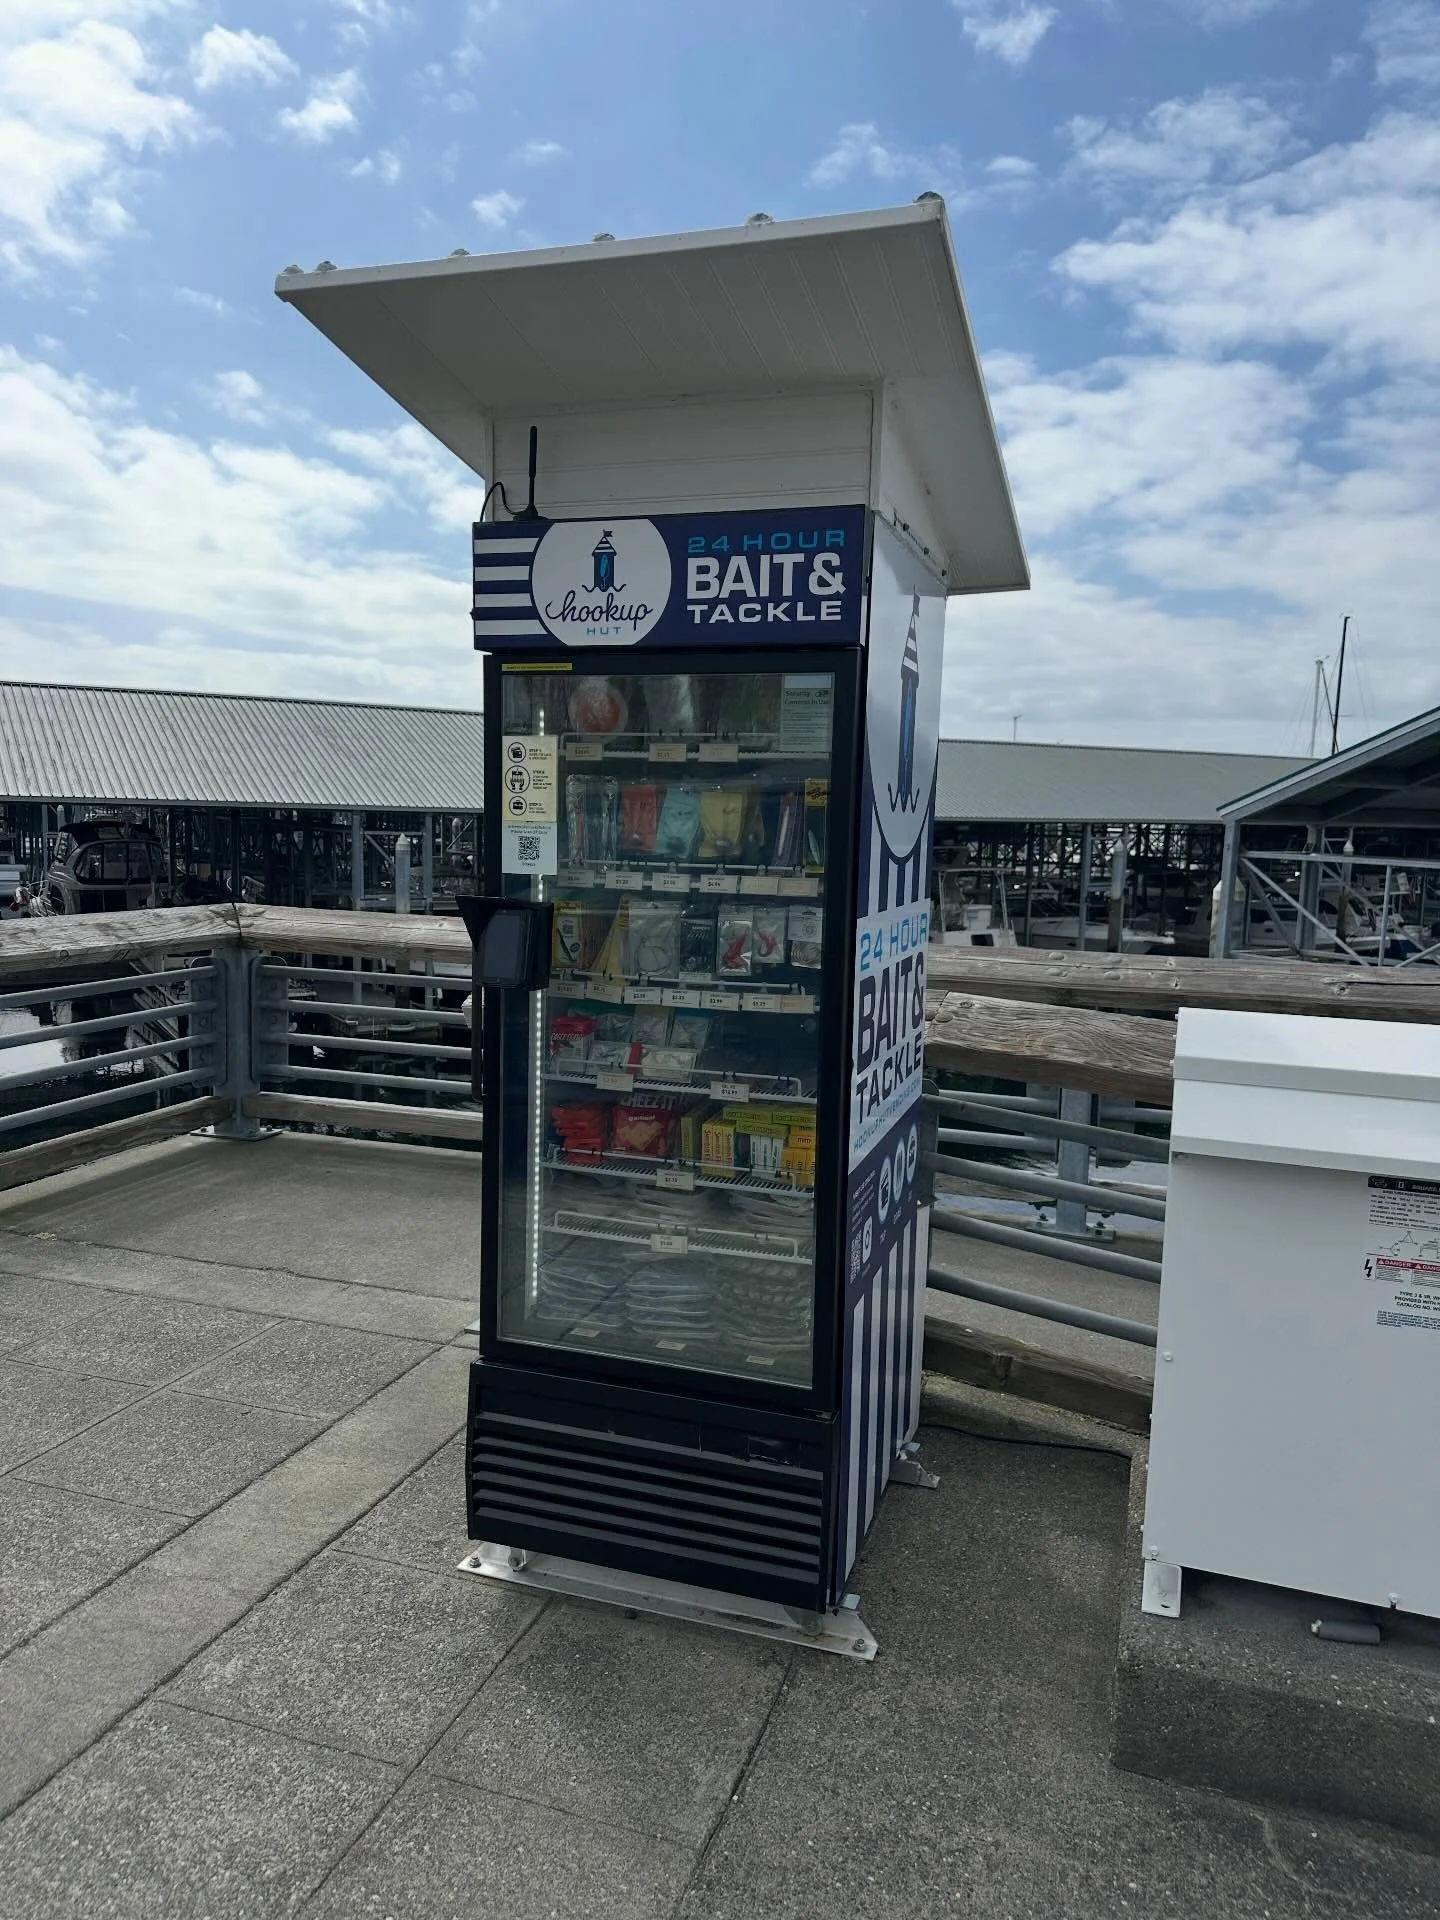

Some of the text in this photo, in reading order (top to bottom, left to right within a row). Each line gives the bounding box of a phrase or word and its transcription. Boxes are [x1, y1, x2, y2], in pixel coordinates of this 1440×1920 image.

[688, 529, 845, 552] 24 HOUR
[545, 590, 653, 631] hookup
[687, 600, 842, 624] TACKLE
[586, 627, 622, 635] HUT
[860, 913, 927, 971] 24 HOUR
[856, 1031, 922, 1124] TACKLE
[1384, 1259, 1412, 1268] DANGER
